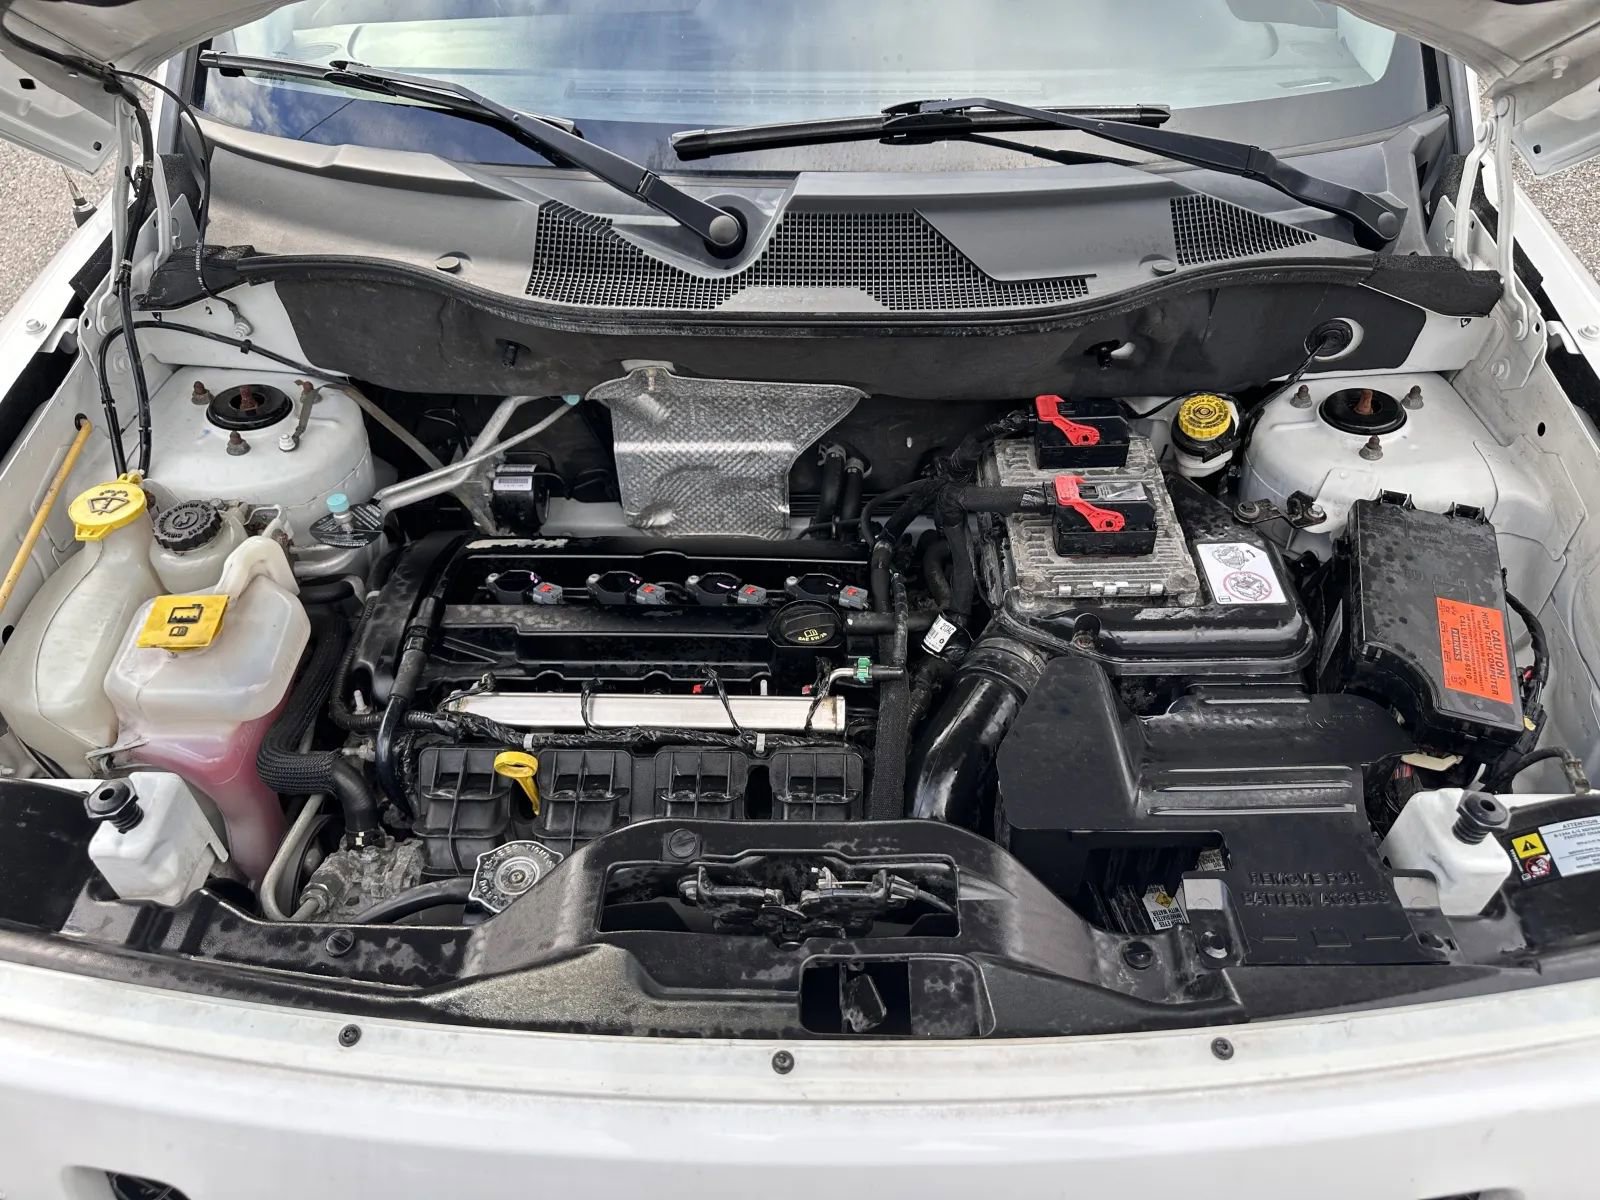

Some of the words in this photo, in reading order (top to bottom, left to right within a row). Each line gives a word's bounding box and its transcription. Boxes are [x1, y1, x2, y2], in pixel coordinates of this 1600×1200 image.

[1481, 611, 1490, 629] HIGH
[1483, 631, 1492, 651] TECH
[1491, 629, 1506, 680] CAUTION!
[1486, 652, 1498, 695] COMPUTER
[1248, 872, 1323, 886] REMOVE
[1324, 872, 1363, 885] FOR
[1243, 891, 1314, 907] BATTERY
[1319, 889, 1391, 906] ACCESS
